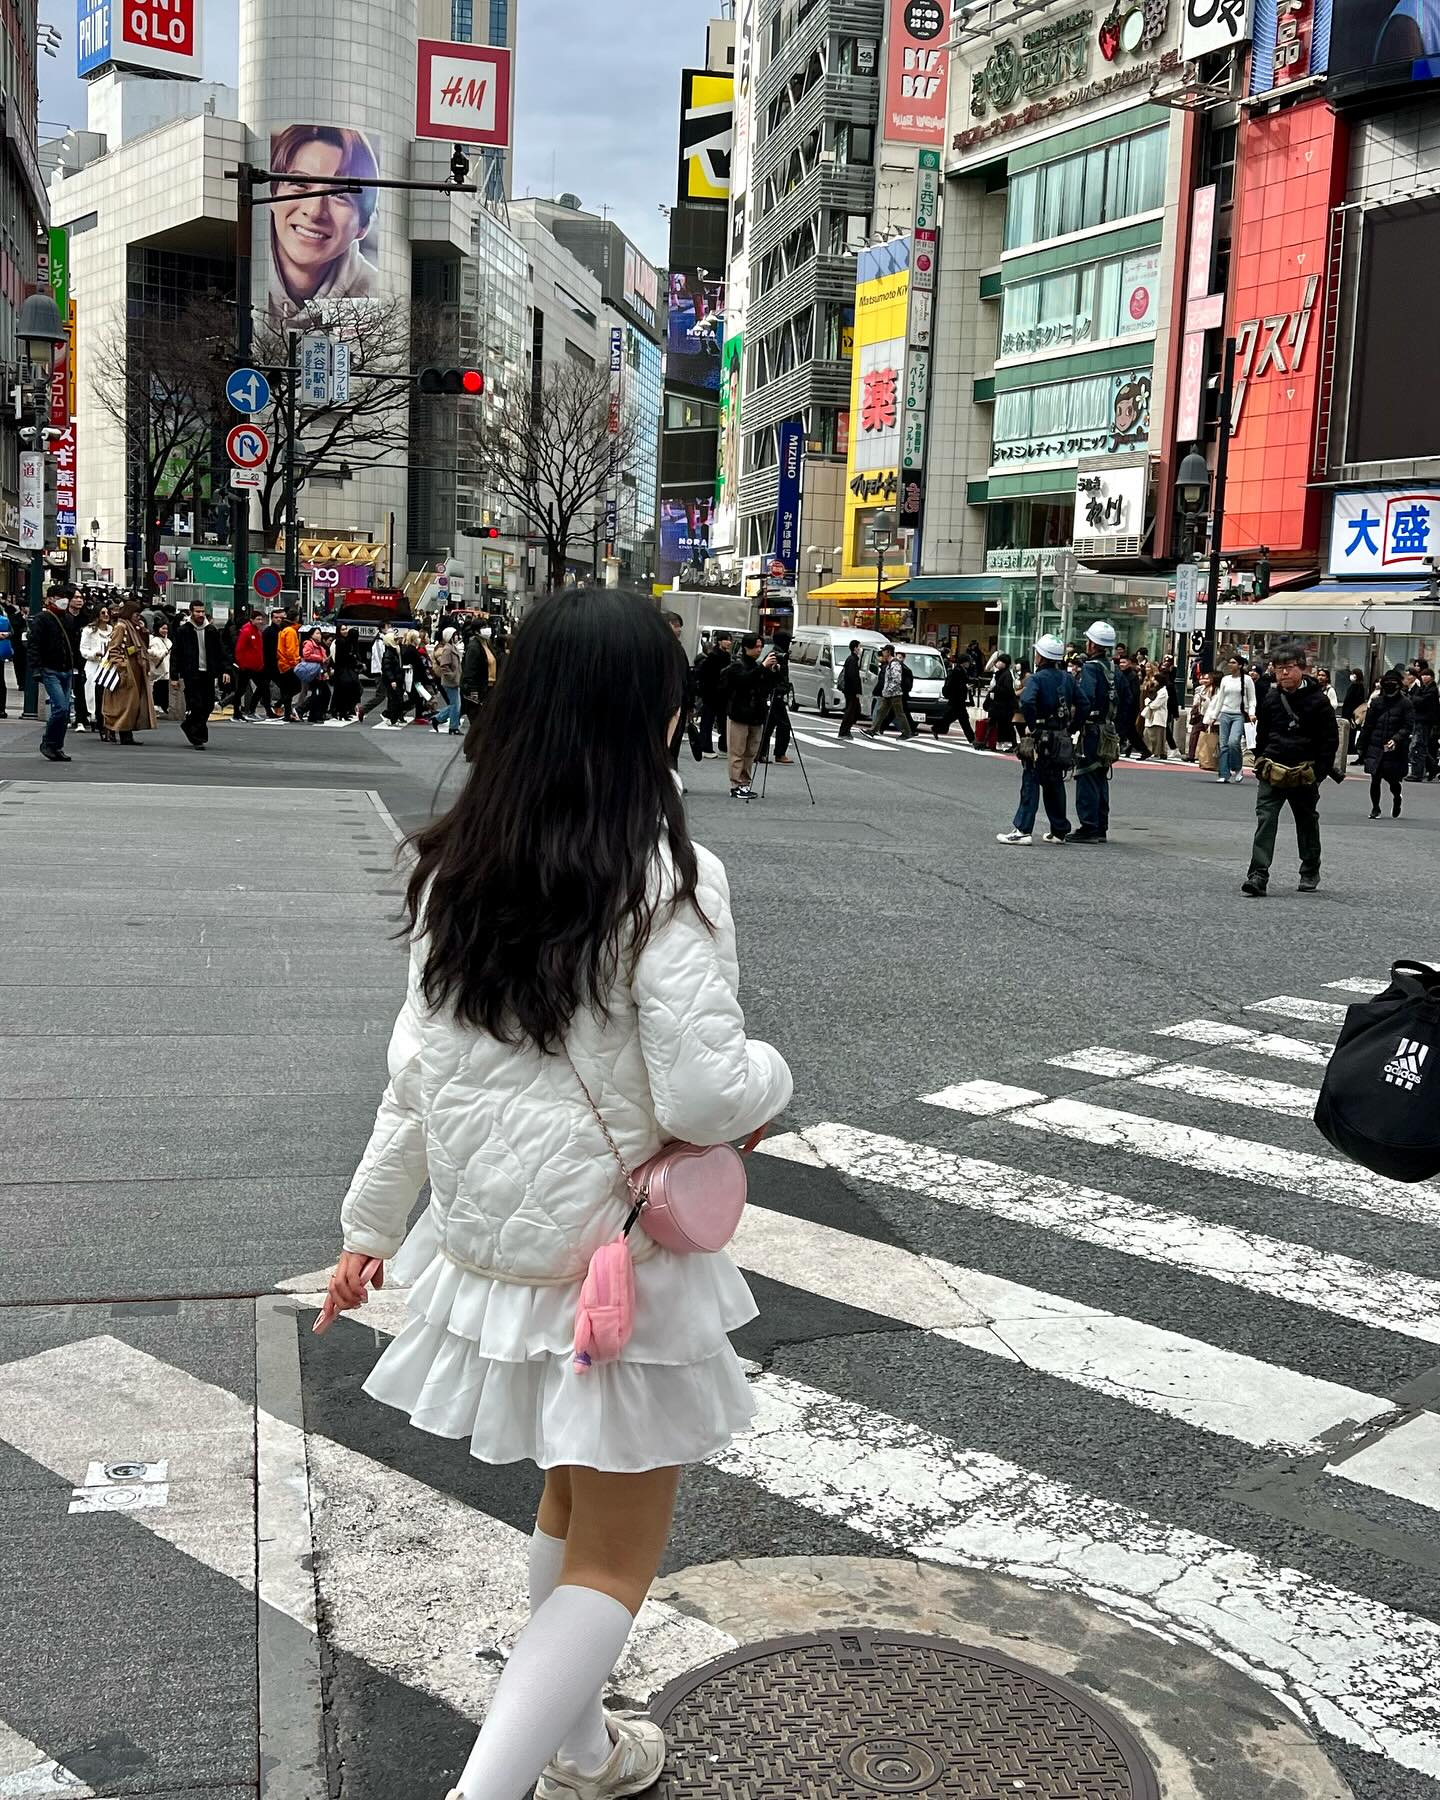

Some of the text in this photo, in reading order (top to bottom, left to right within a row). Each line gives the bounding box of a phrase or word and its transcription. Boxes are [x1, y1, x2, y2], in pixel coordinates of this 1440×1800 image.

[80, 6, 109, 60] PRIME
[131, 9, 186, 44] QLO
[904, 47, 940, 71] B1F
[440, 76, 487, 111] H&M
[902, 74, 941, 99] B2F
[52, 258, 63, 288] レイク
[859, 290, 897, 307] Matsumoto
[313, 341, 326, 399] 渋谷駅前
[336, 345, 346, 399] スクランブル式
[611, 341, 620, 370] LABI
[52, 372, 65, 408] アコム
[863, 367, 899, 432] 薬
[53, 426, 75, 508] スギ薬局
[787, 434, 799, 479] MIZUHO
[1085, 494, 1123, 528] 松川
[678, 537, 708, 547] NORA
[782, 511, 793, 558] みずほ銀行
[1344, 504, 1431, 558] 大盛
[313, 567, 340, 587] 109
[1383, 1063, 1423, 1084] adidas
